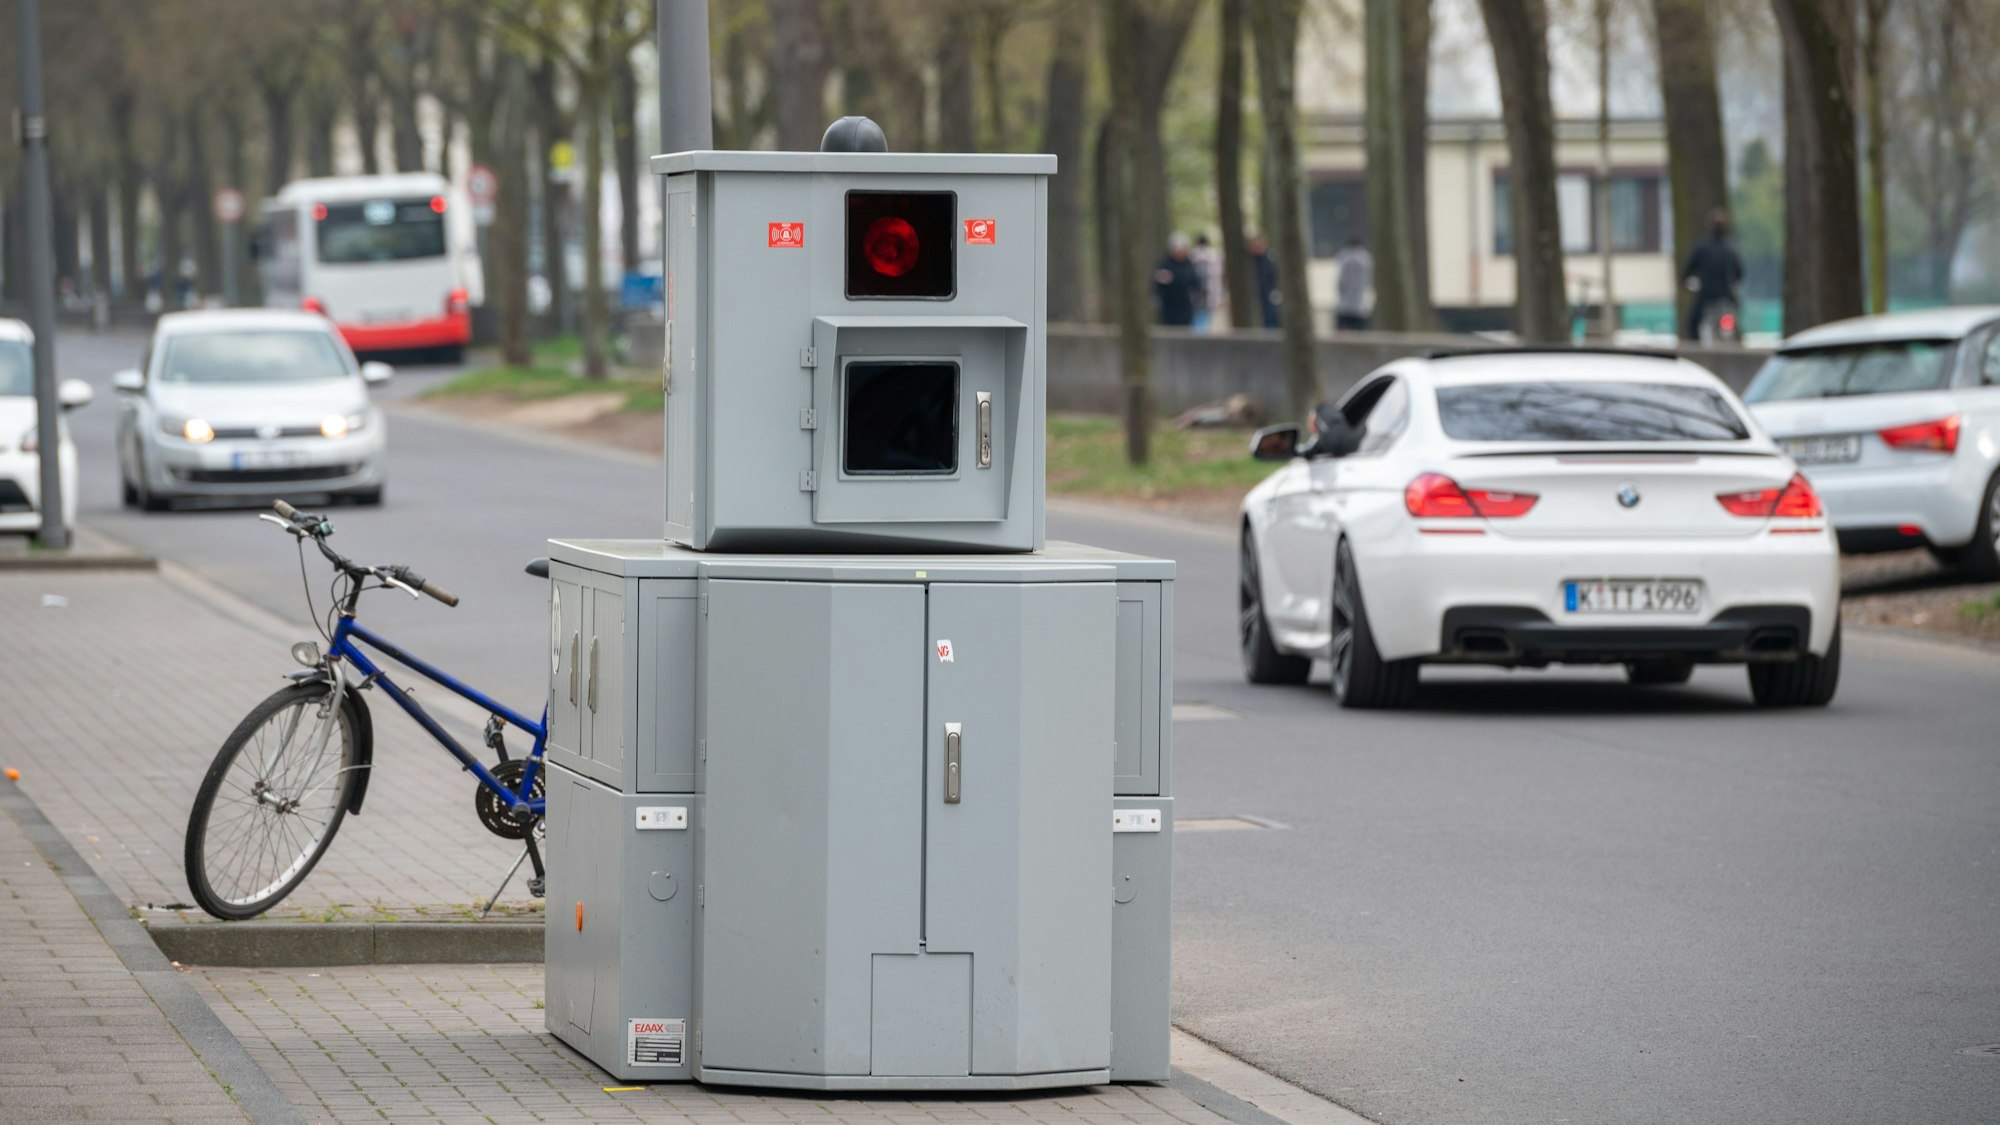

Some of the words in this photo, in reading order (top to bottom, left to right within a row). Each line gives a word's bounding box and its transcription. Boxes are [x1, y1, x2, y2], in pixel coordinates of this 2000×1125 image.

[1580, 583, 1593, 610] K
[1610, 582, 1635, 608] TT
[1642, 582, 1696, 610] 1996
